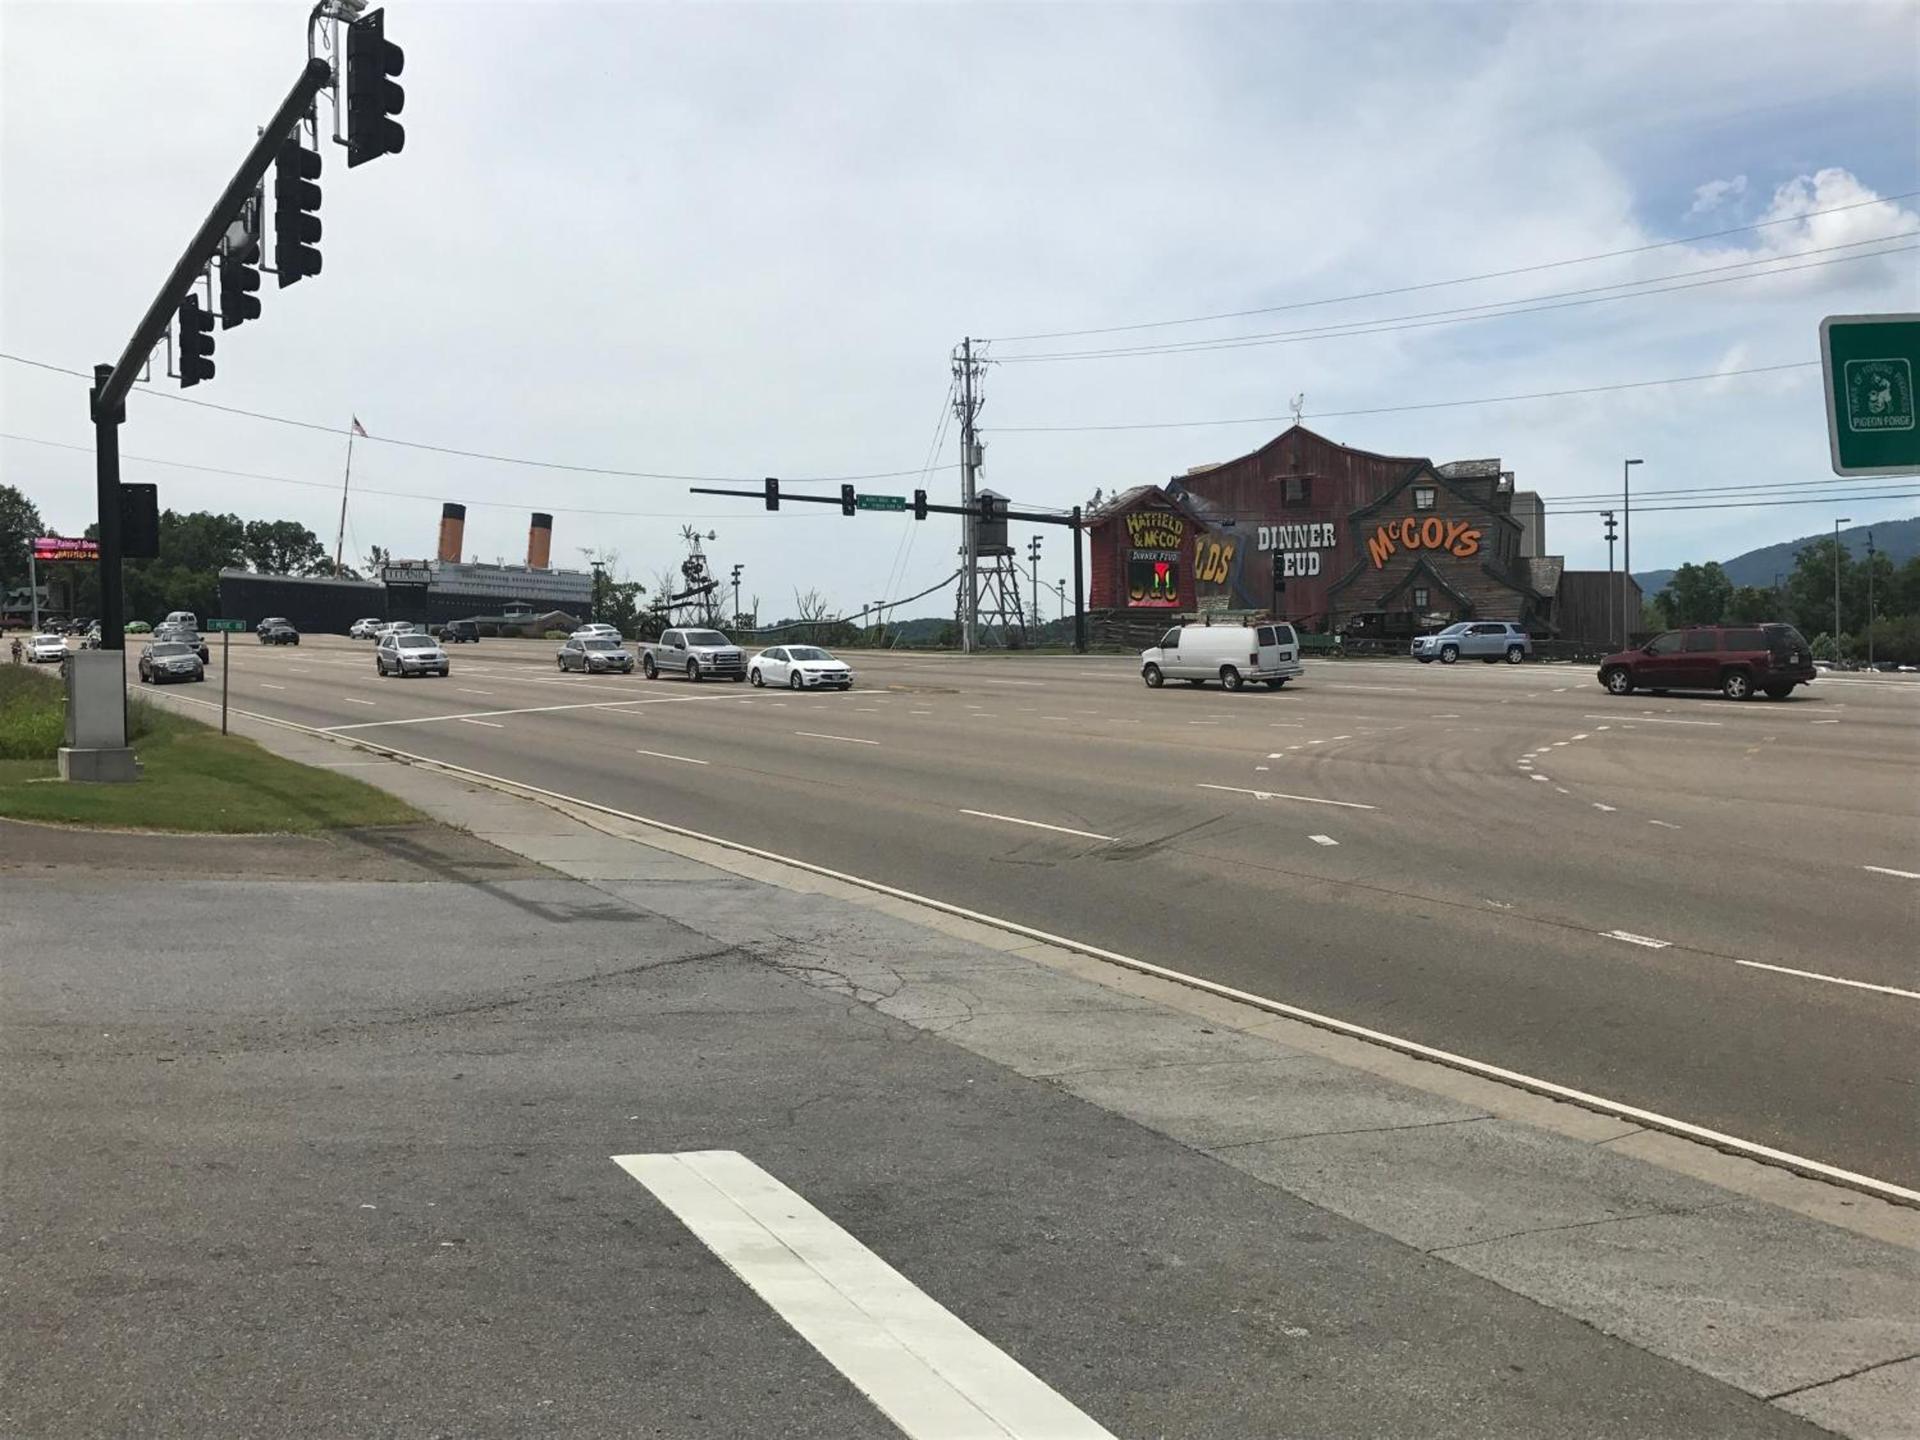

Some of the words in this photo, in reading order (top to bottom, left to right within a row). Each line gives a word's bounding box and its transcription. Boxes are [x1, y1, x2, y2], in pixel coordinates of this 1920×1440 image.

[1853, 416, 1883, 427] PIGEON
[1884, 415, 1911, 426] FORGE
[1126, 512, 1183, 535] HATFIELD
[1133, 533, 1143, 547] &
[1258, 523, 1337, 550] DINNER
[1132, 551, 1157, 560] DINNER
[1272, 551, 1320, 577] EUD
